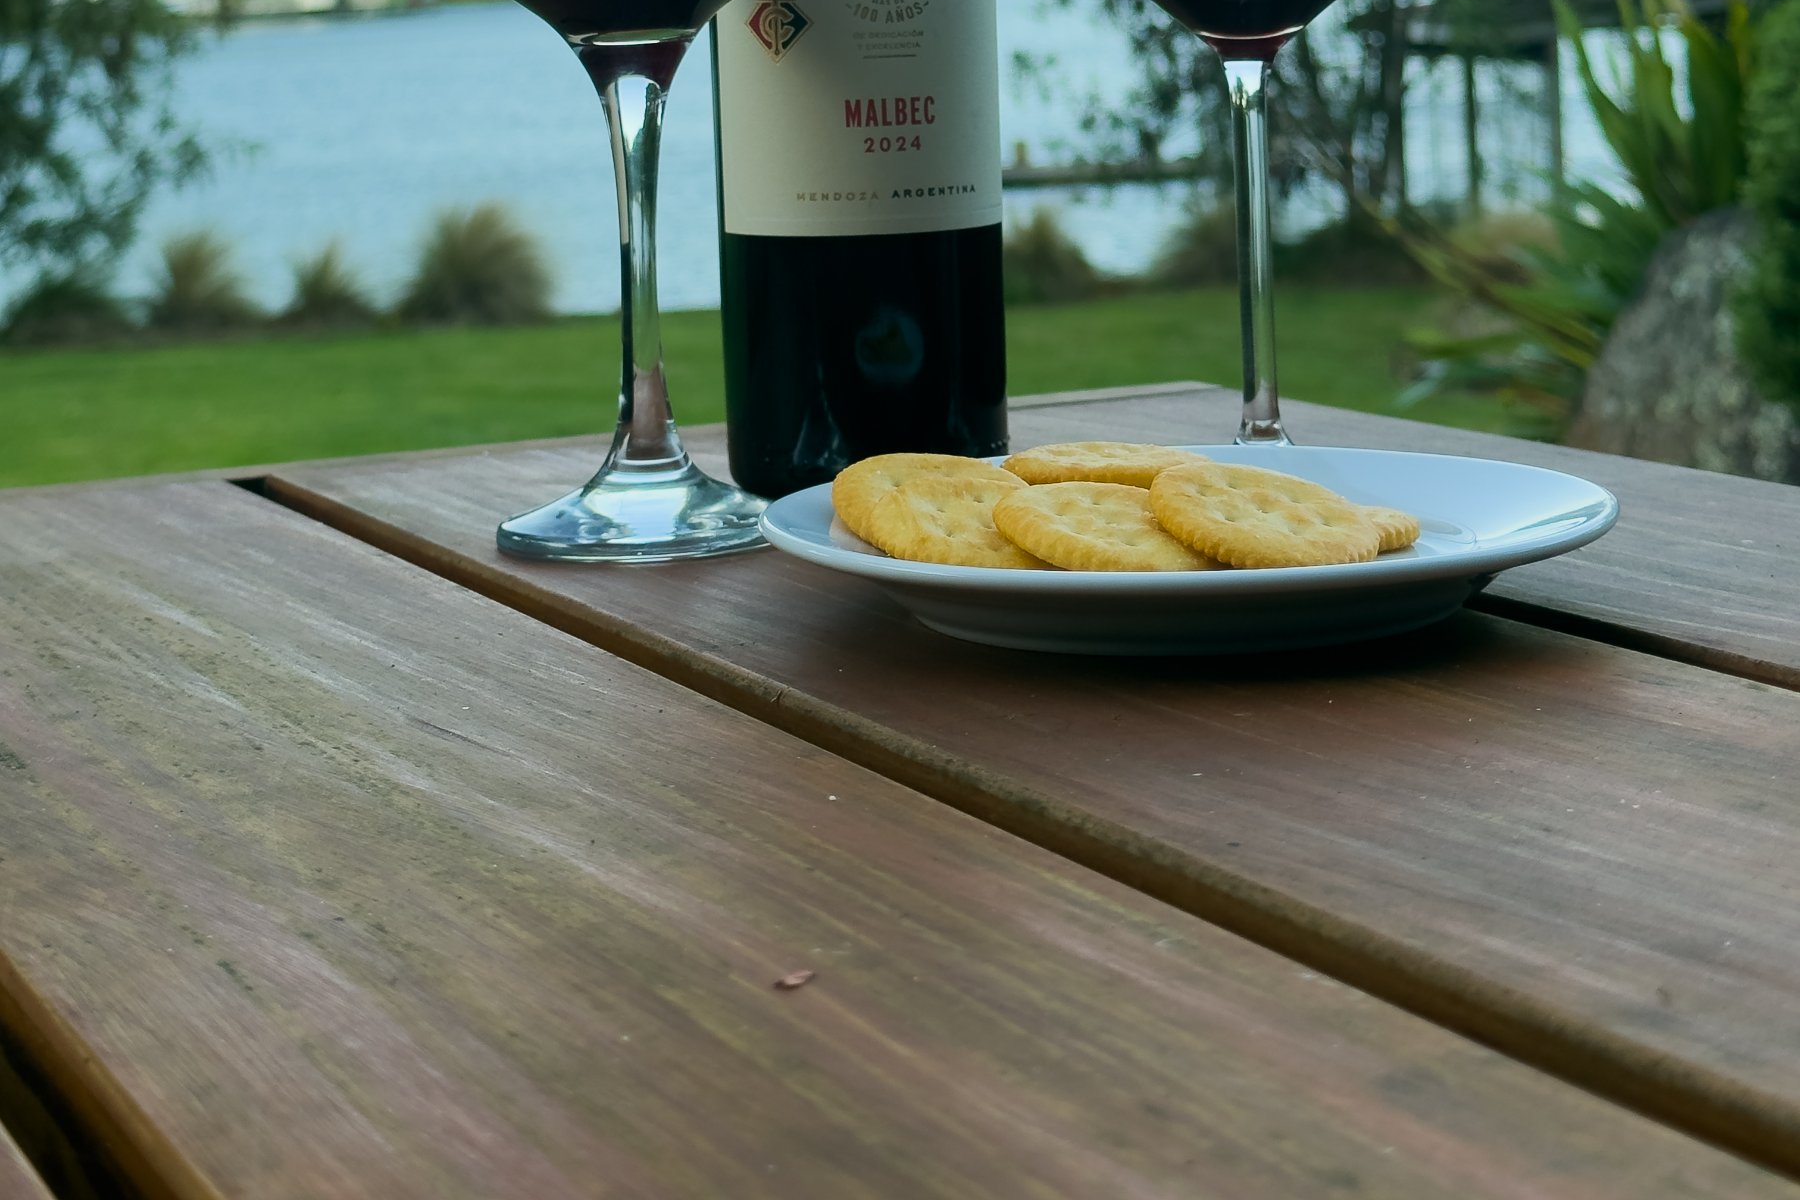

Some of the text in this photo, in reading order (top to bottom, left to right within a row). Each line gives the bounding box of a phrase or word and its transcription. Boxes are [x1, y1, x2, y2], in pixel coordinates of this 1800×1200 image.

[853, 1, 924, 24] 100 AÑOS
[845, 95, 936, 128] MALBEC
[864, 136, 922, 153] 2024
[796, 184, 977, 202] MENDOZA ARGENTINA
